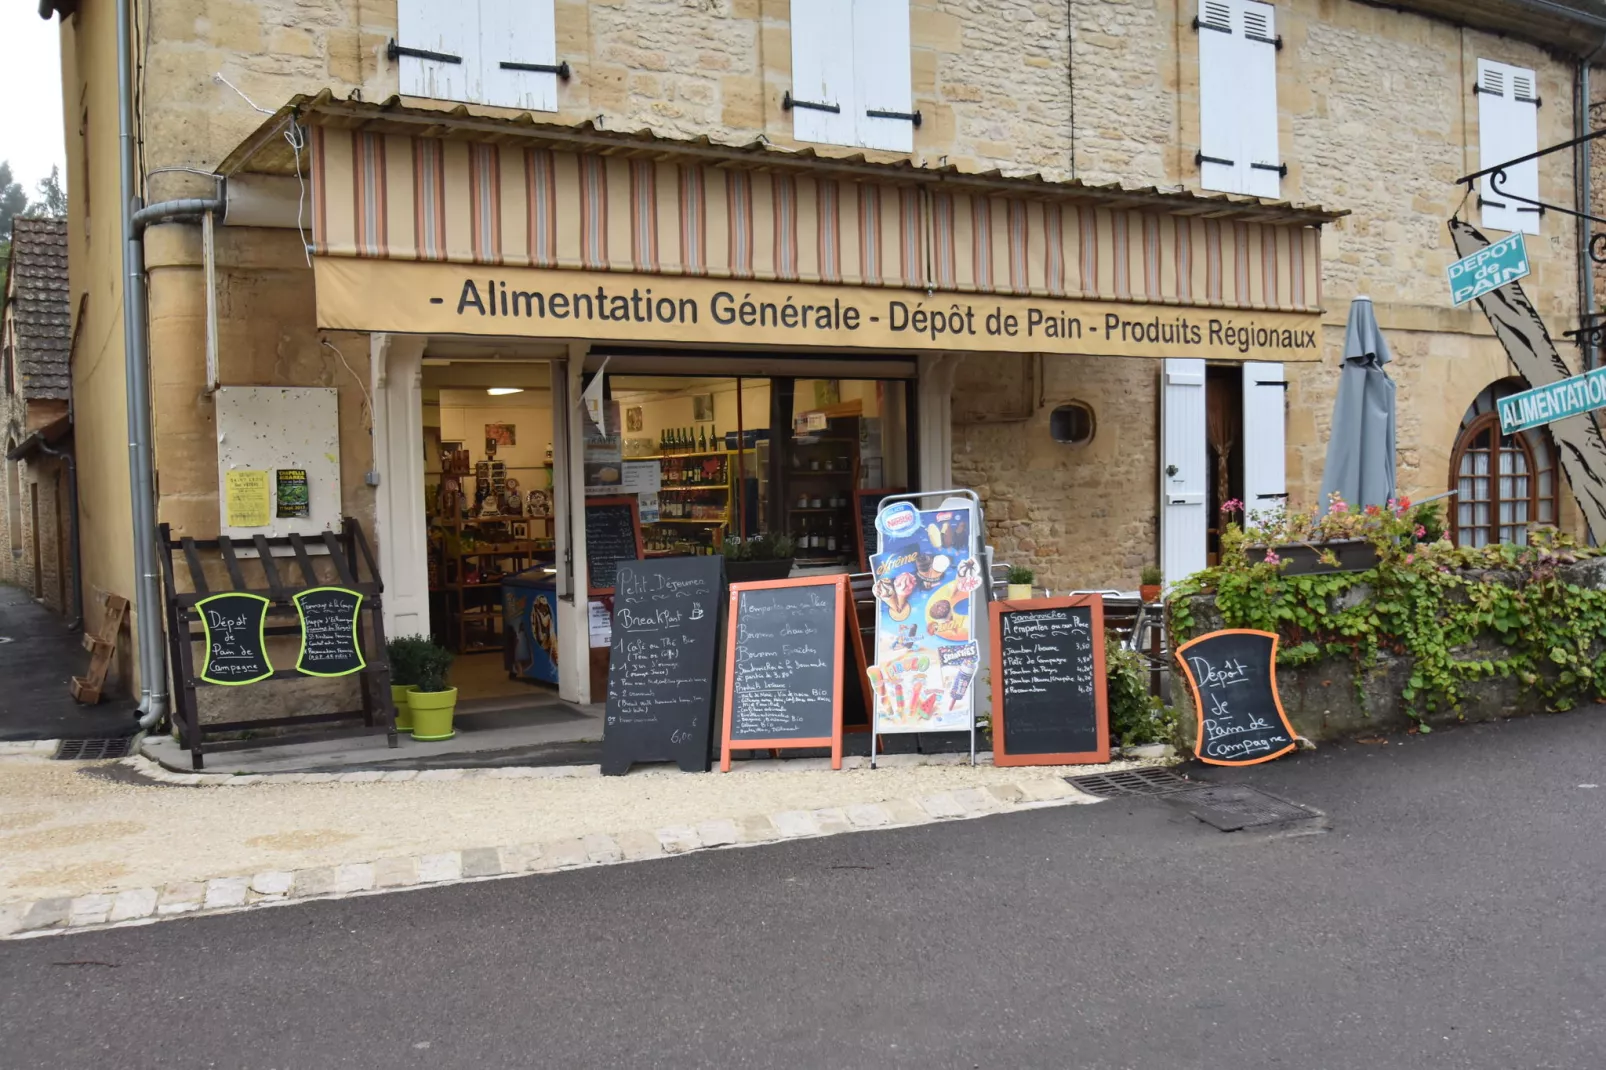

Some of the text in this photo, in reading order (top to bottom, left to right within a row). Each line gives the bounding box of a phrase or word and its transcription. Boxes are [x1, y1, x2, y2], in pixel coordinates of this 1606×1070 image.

[1449, 236, 1520, 279] DEPOT
[1455, 260, 1526, 302] PAIN
[1474, 264, 1499, 280] de
[457, 279, 698, 325] Alimentation
[710, 291, 861, 331] Générale
[889, 301, 976, 341] Dépôt
[986, 307, 1018, 336] de
[1028, 308, 1082, 339] Pain
[1105, 313, 1202, 345] Produits
[1209, 318, 1317, 353] Régionaux
[740, 593, 747, 613] A
[208, 610, 247, 632] Dépôt
[1004, 616, 1011, 636] A
[1013, 619, 1048, 637] emporter
[225, 631, 235, 641] de
[627, 639, 646, 654] Café
[213, 643, 253, 656] Pain de
[209, 660, 258, 673] Campagne
[1188, 656, 1248, 688] Dépôt
[1211, 693, 1229, 715] de
[1202, 713, 1268, 740] Pain de
[1207, 735, 1287, 756] Campagne
